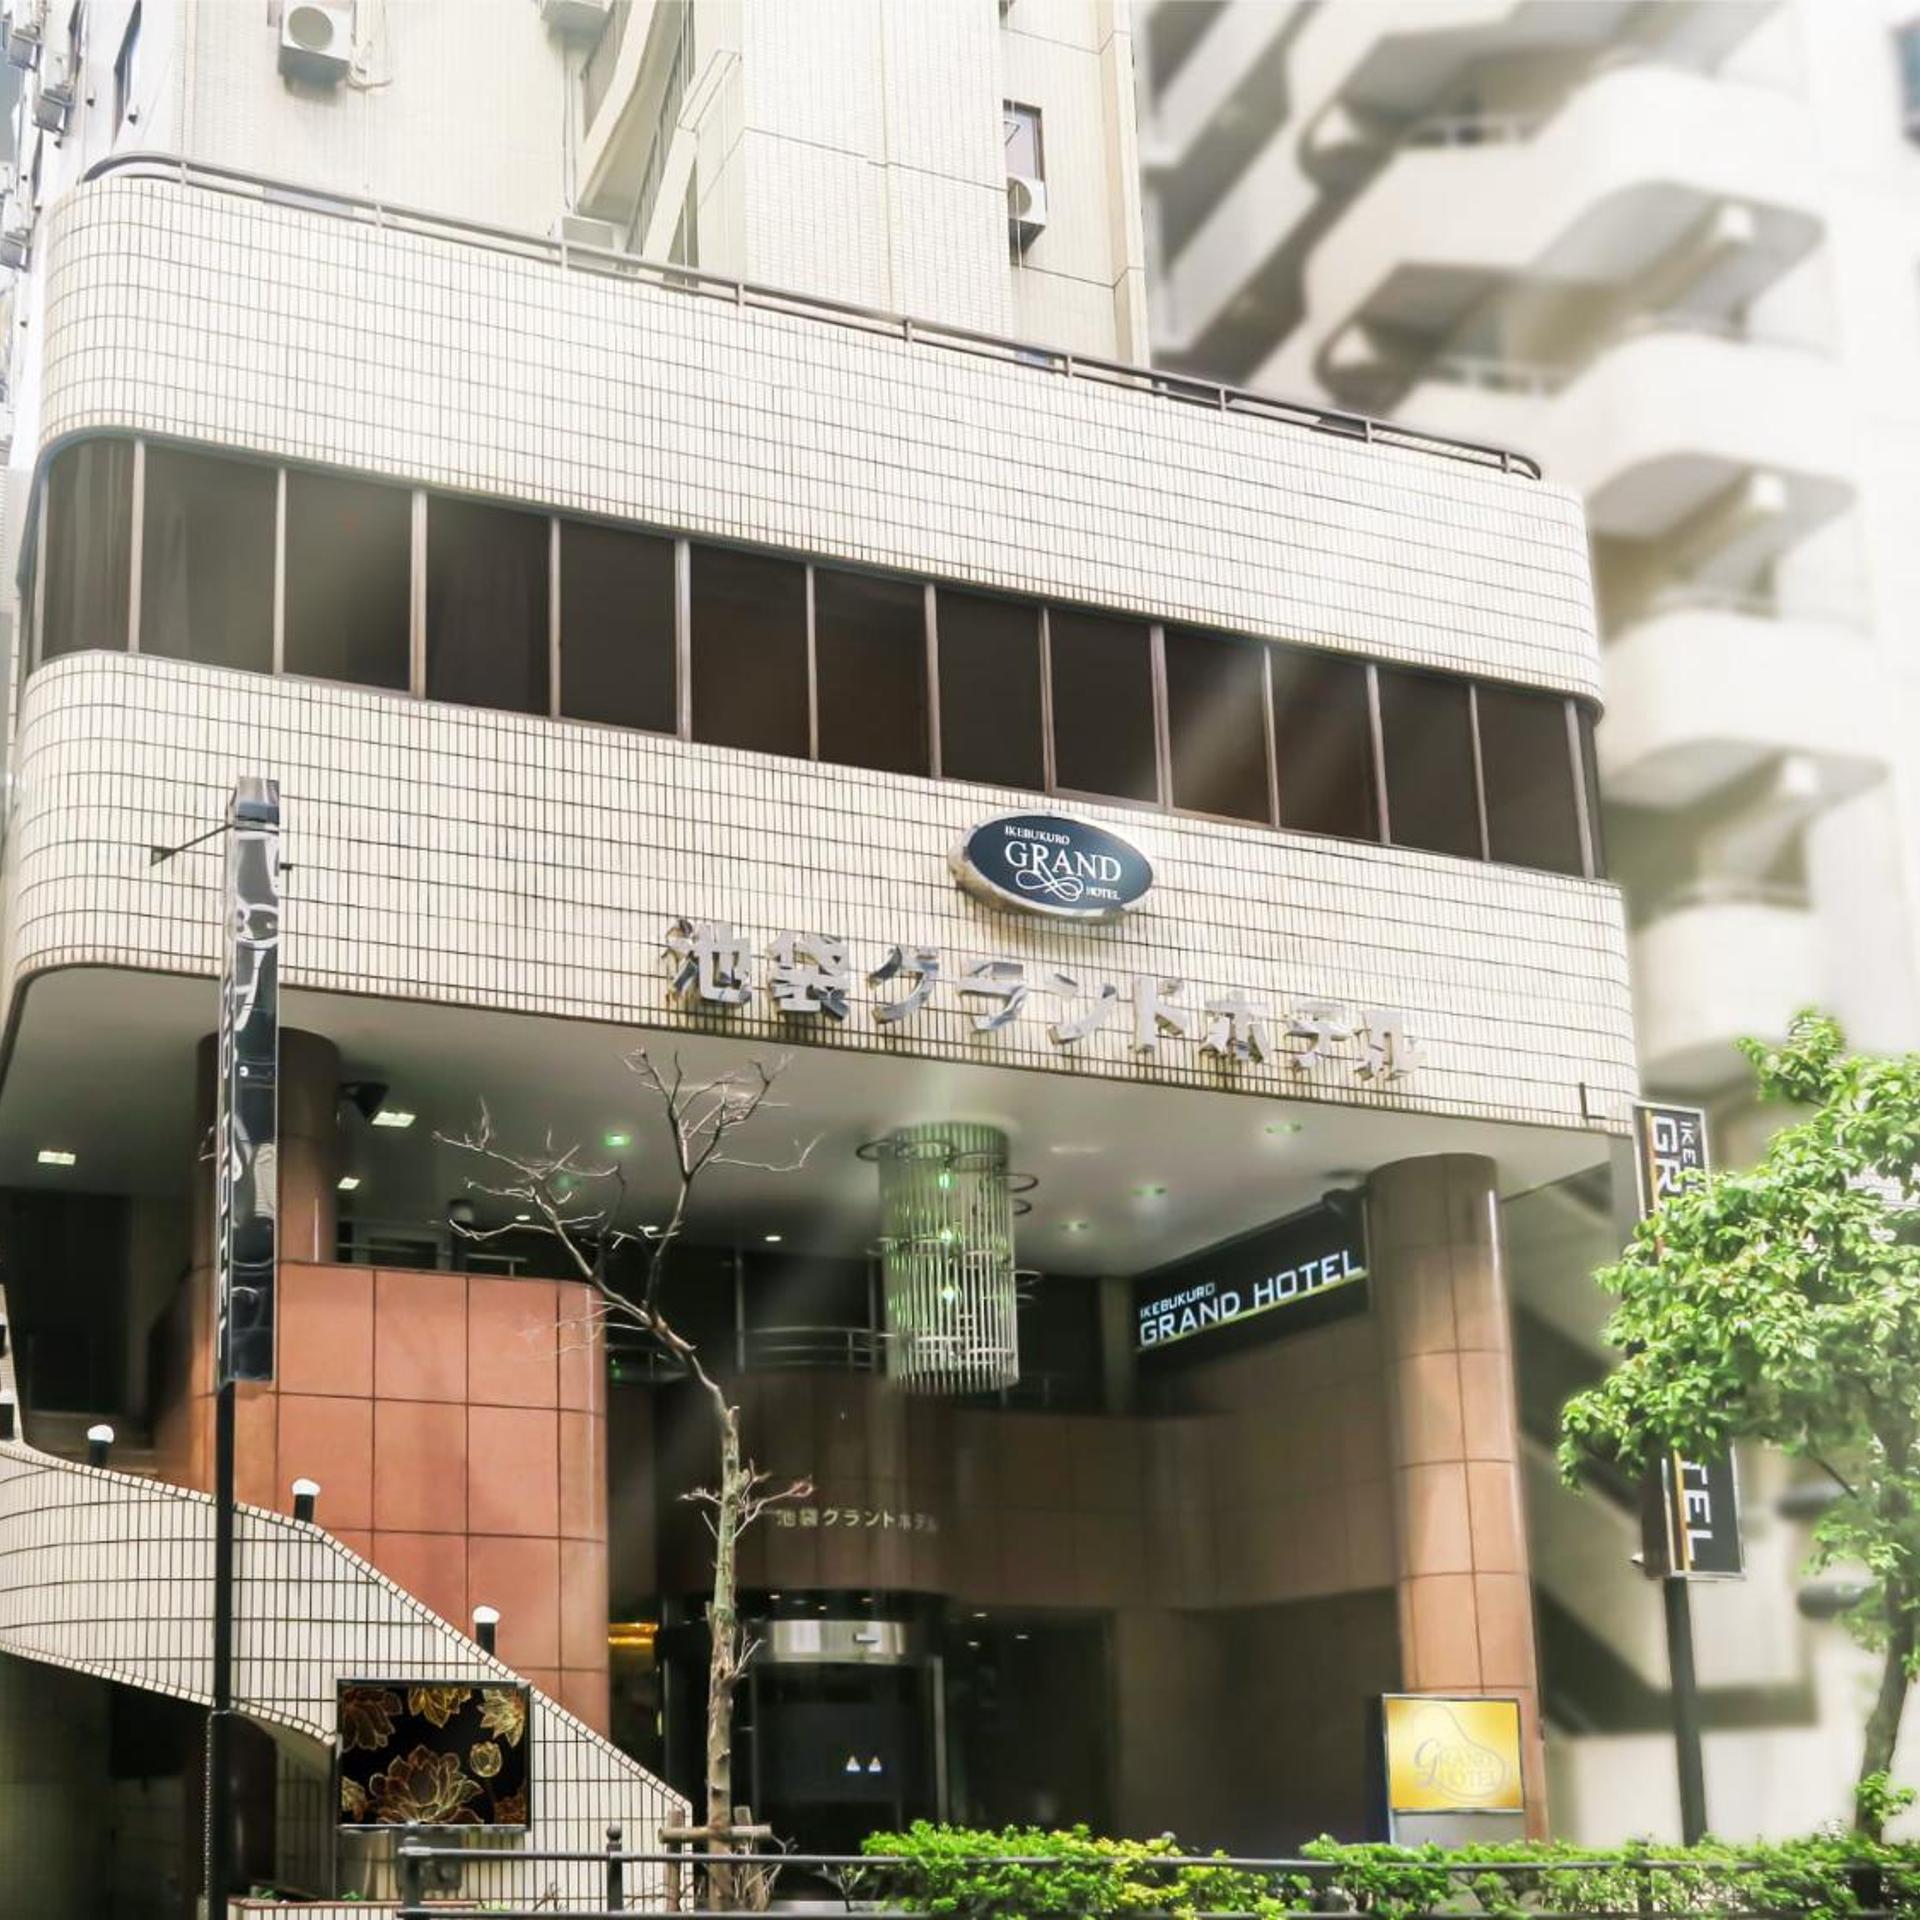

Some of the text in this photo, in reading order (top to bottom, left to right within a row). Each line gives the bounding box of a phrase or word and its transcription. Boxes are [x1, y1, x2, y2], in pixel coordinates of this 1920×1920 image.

[1004, 824, 1071, 846] IKEBUKURO
[1004, 840, 1122, 884] GRAND
[1085, 886, 1121, 900] HOTEL
[661, 918, 1428, 1081] 池袋グランドホテル
[1140, 1249, 1364, 1348] GRAND HOTEL
[1140, 1282, 1216, 1320] IKEBUKURO
